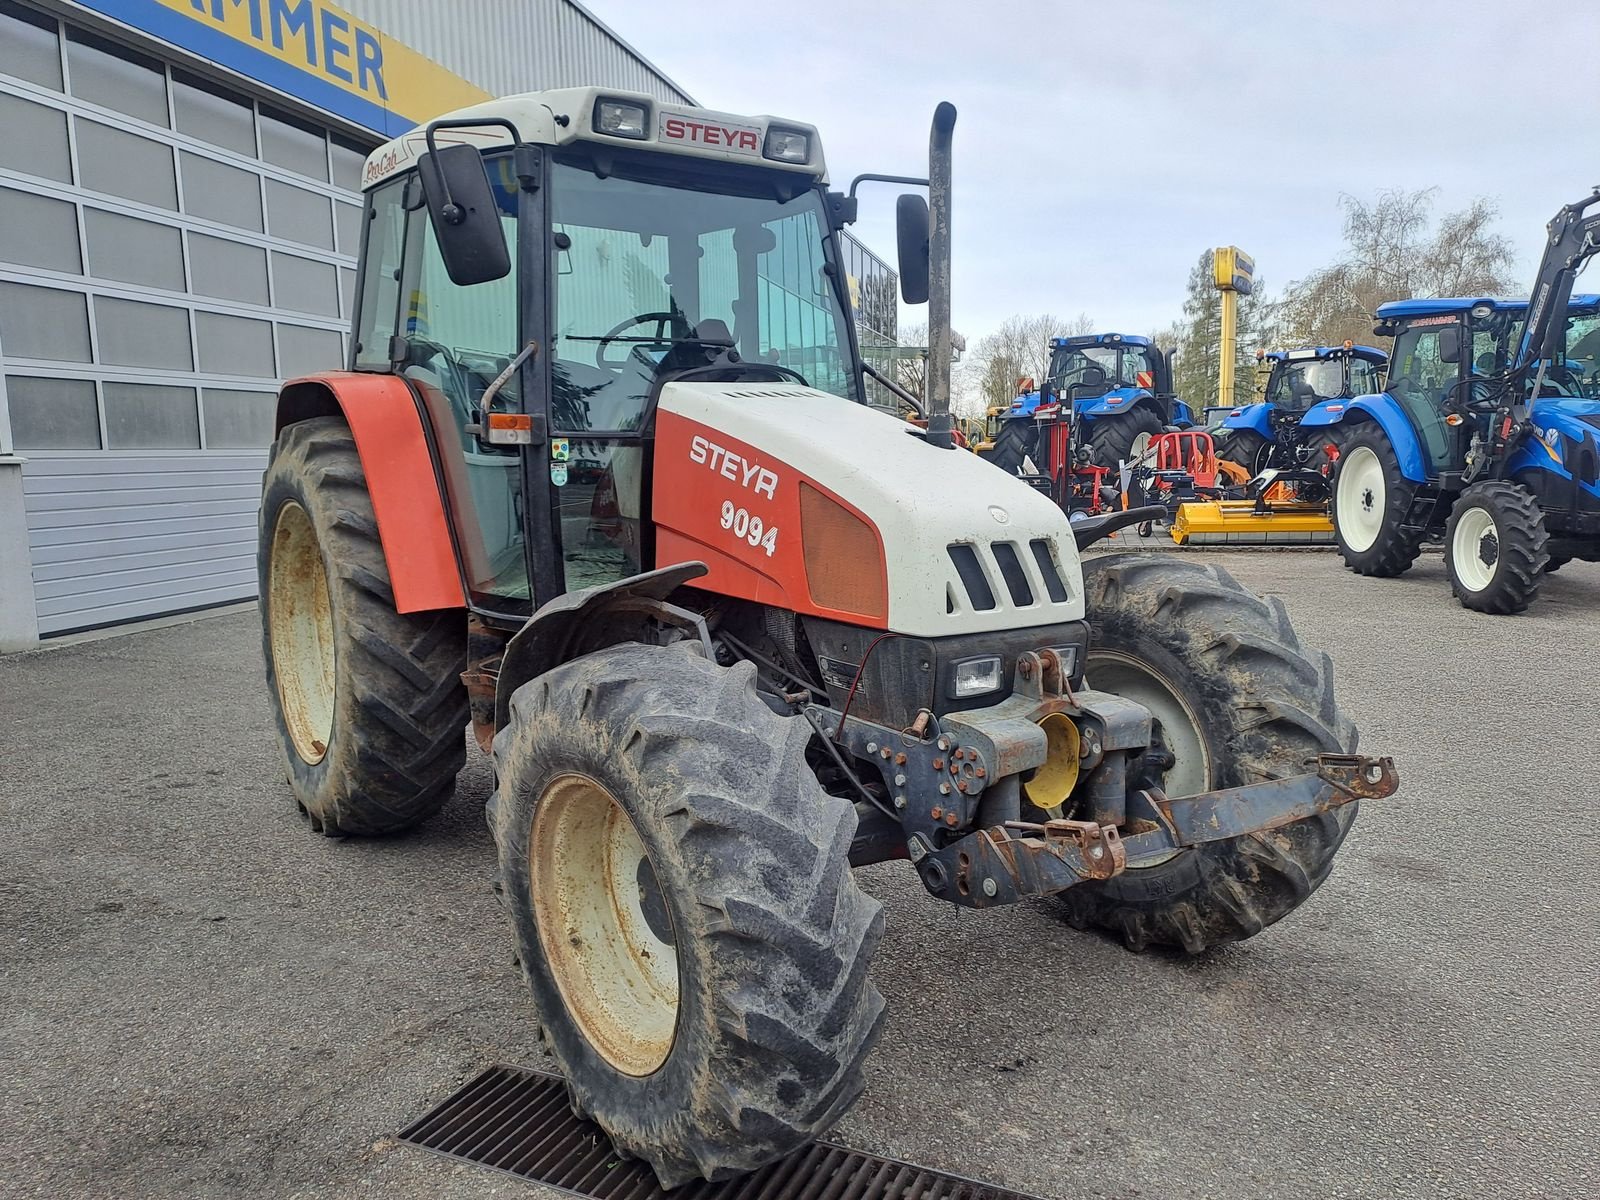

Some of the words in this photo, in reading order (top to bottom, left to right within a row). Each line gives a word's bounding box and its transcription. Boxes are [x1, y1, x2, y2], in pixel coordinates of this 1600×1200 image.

[190, 0, 389, 101] MMER
[666, 119, 757, 150] STEYR
[690, 435, 778, 500] STEYR
[721, 500, 778, 557] 9094
